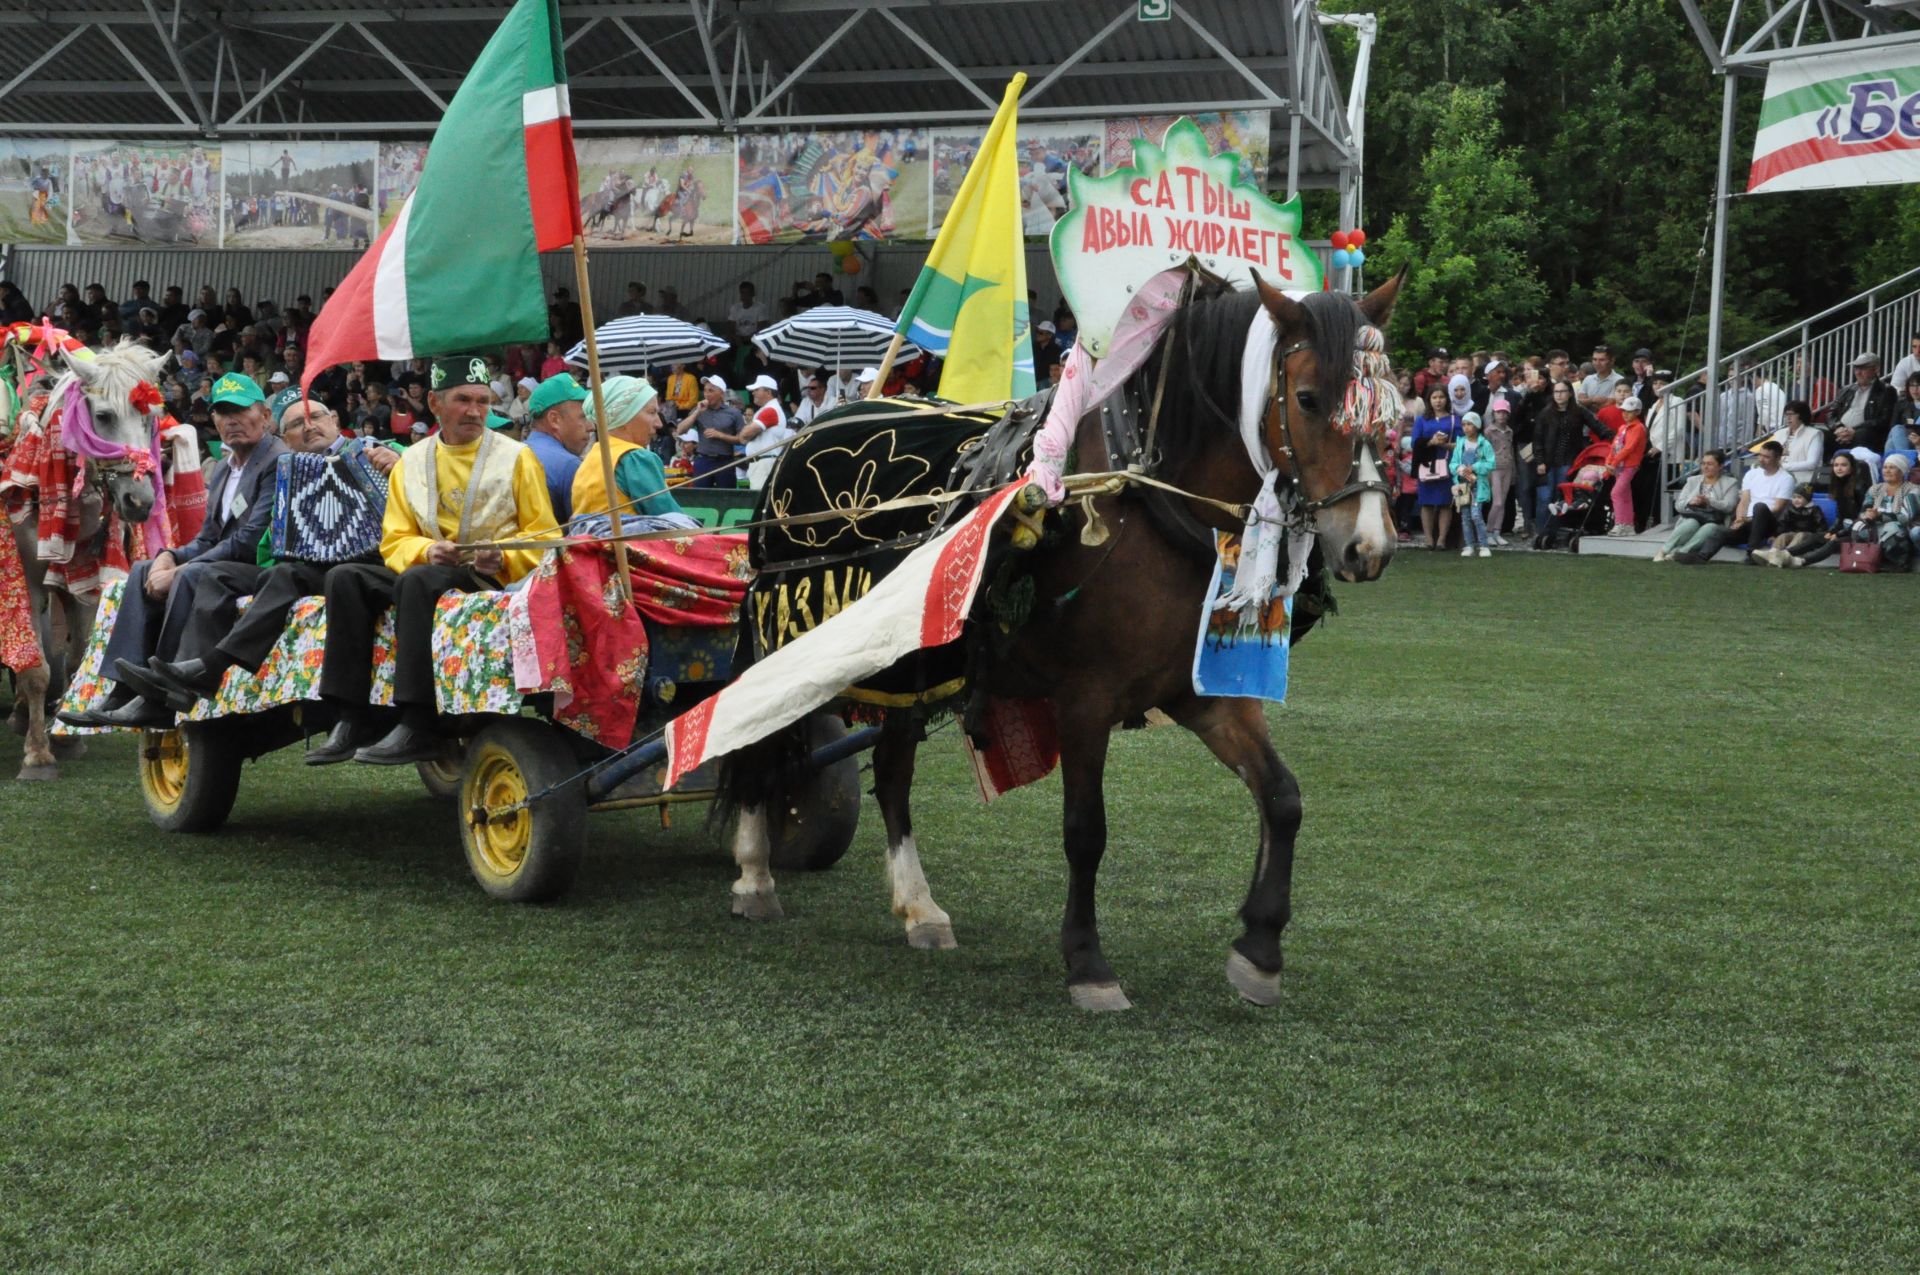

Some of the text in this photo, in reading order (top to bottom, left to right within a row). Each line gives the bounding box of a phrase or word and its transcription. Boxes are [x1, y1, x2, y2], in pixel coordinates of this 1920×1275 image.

[1130, 166, 1251, 221] САТЫШ
[1082, 205, 1293, 281] АВЫЛ ЖИРЛЕГЕ
